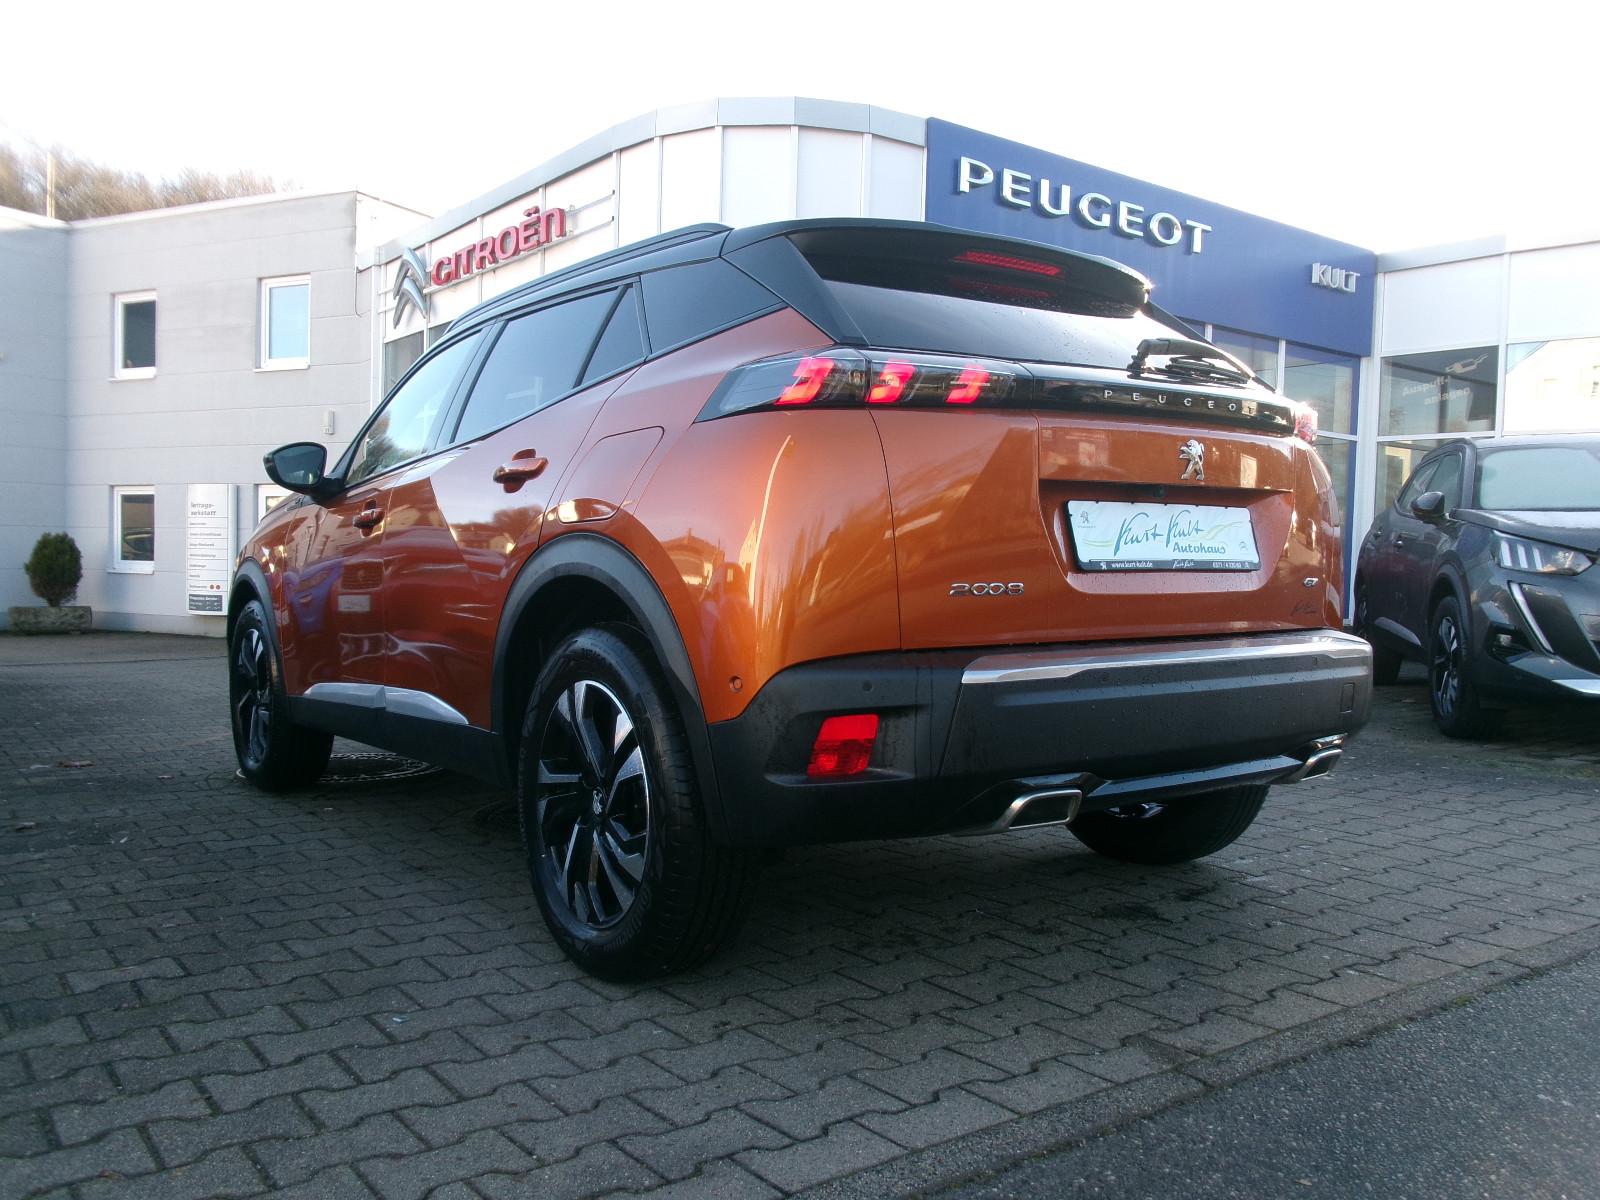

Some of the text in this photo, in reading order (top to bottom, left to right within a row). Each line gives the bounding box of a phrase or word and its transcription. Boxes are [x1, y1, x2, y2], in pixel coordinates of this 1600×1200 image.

[957, 155, 1213, 254] PEUGEOT
[1311, 262, 1361, 293] KULT
[1103, 389, 1255, 415] PEUGEOT
[1172, 542, 1227, 555] Autohaus
[948, 582, 1025, 597] 2008
